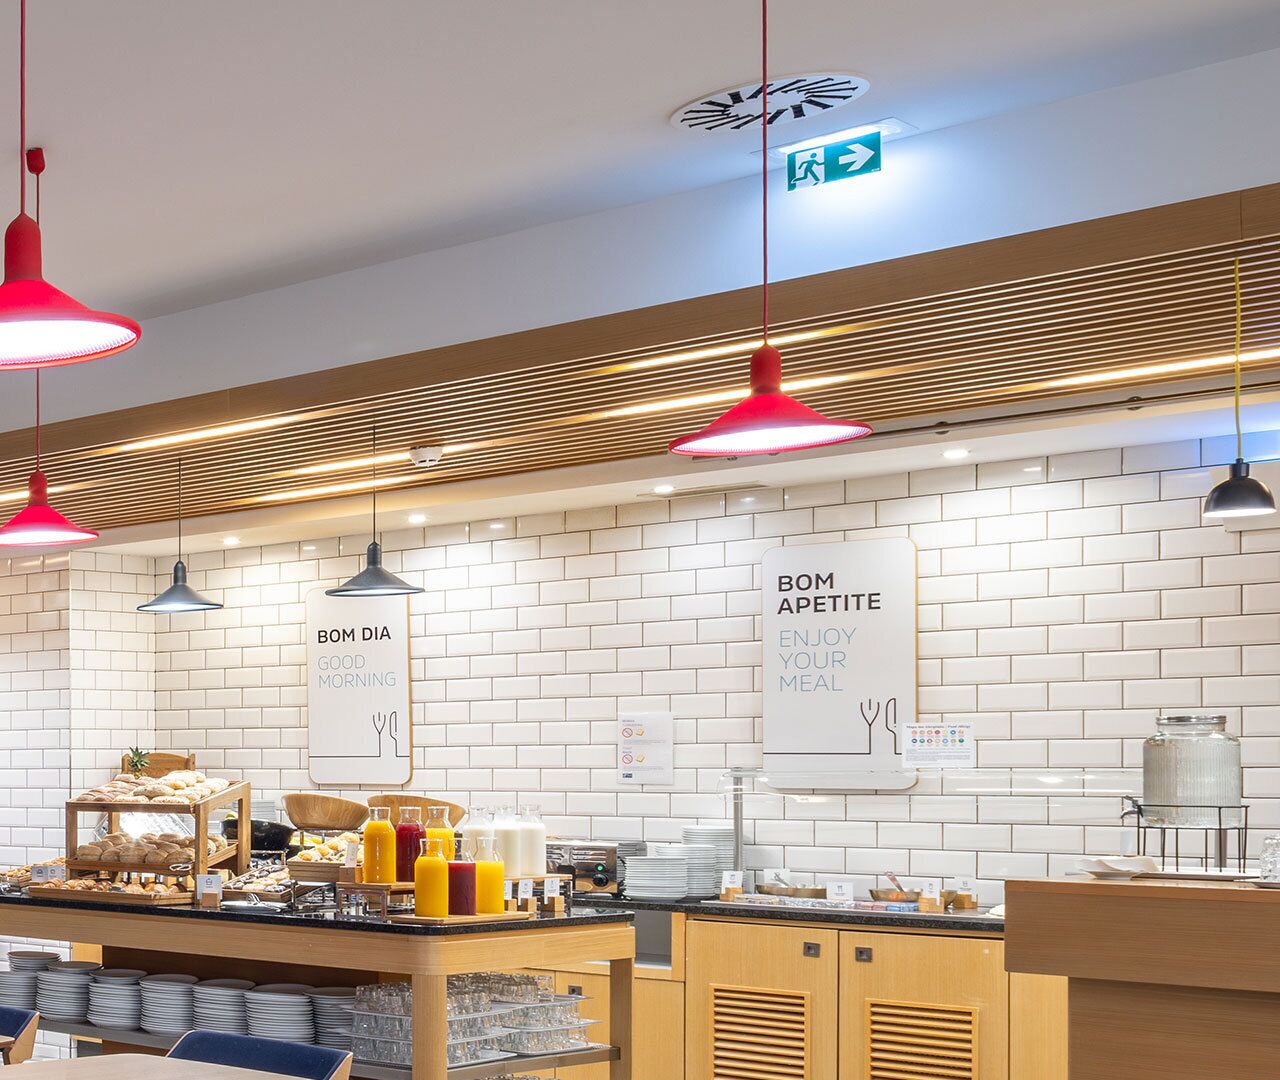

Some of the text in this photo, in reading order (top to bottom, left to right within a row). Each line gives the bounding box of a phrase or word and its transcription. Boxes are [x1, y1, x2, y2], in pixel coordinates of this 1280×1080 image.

[777, 572, 835, 592] BOM
[777, 592, 882, 615] APETITE
[317, 626, 391, 643] BOM DIA
[780, 627, 857, 648] ENJOY
[318, 655, 365, 671] GOOD
[779, 650, 847, 670] YOUR
[318, 672, 397, 689] MORNING
[780, 674, 844, 692] MEAL
